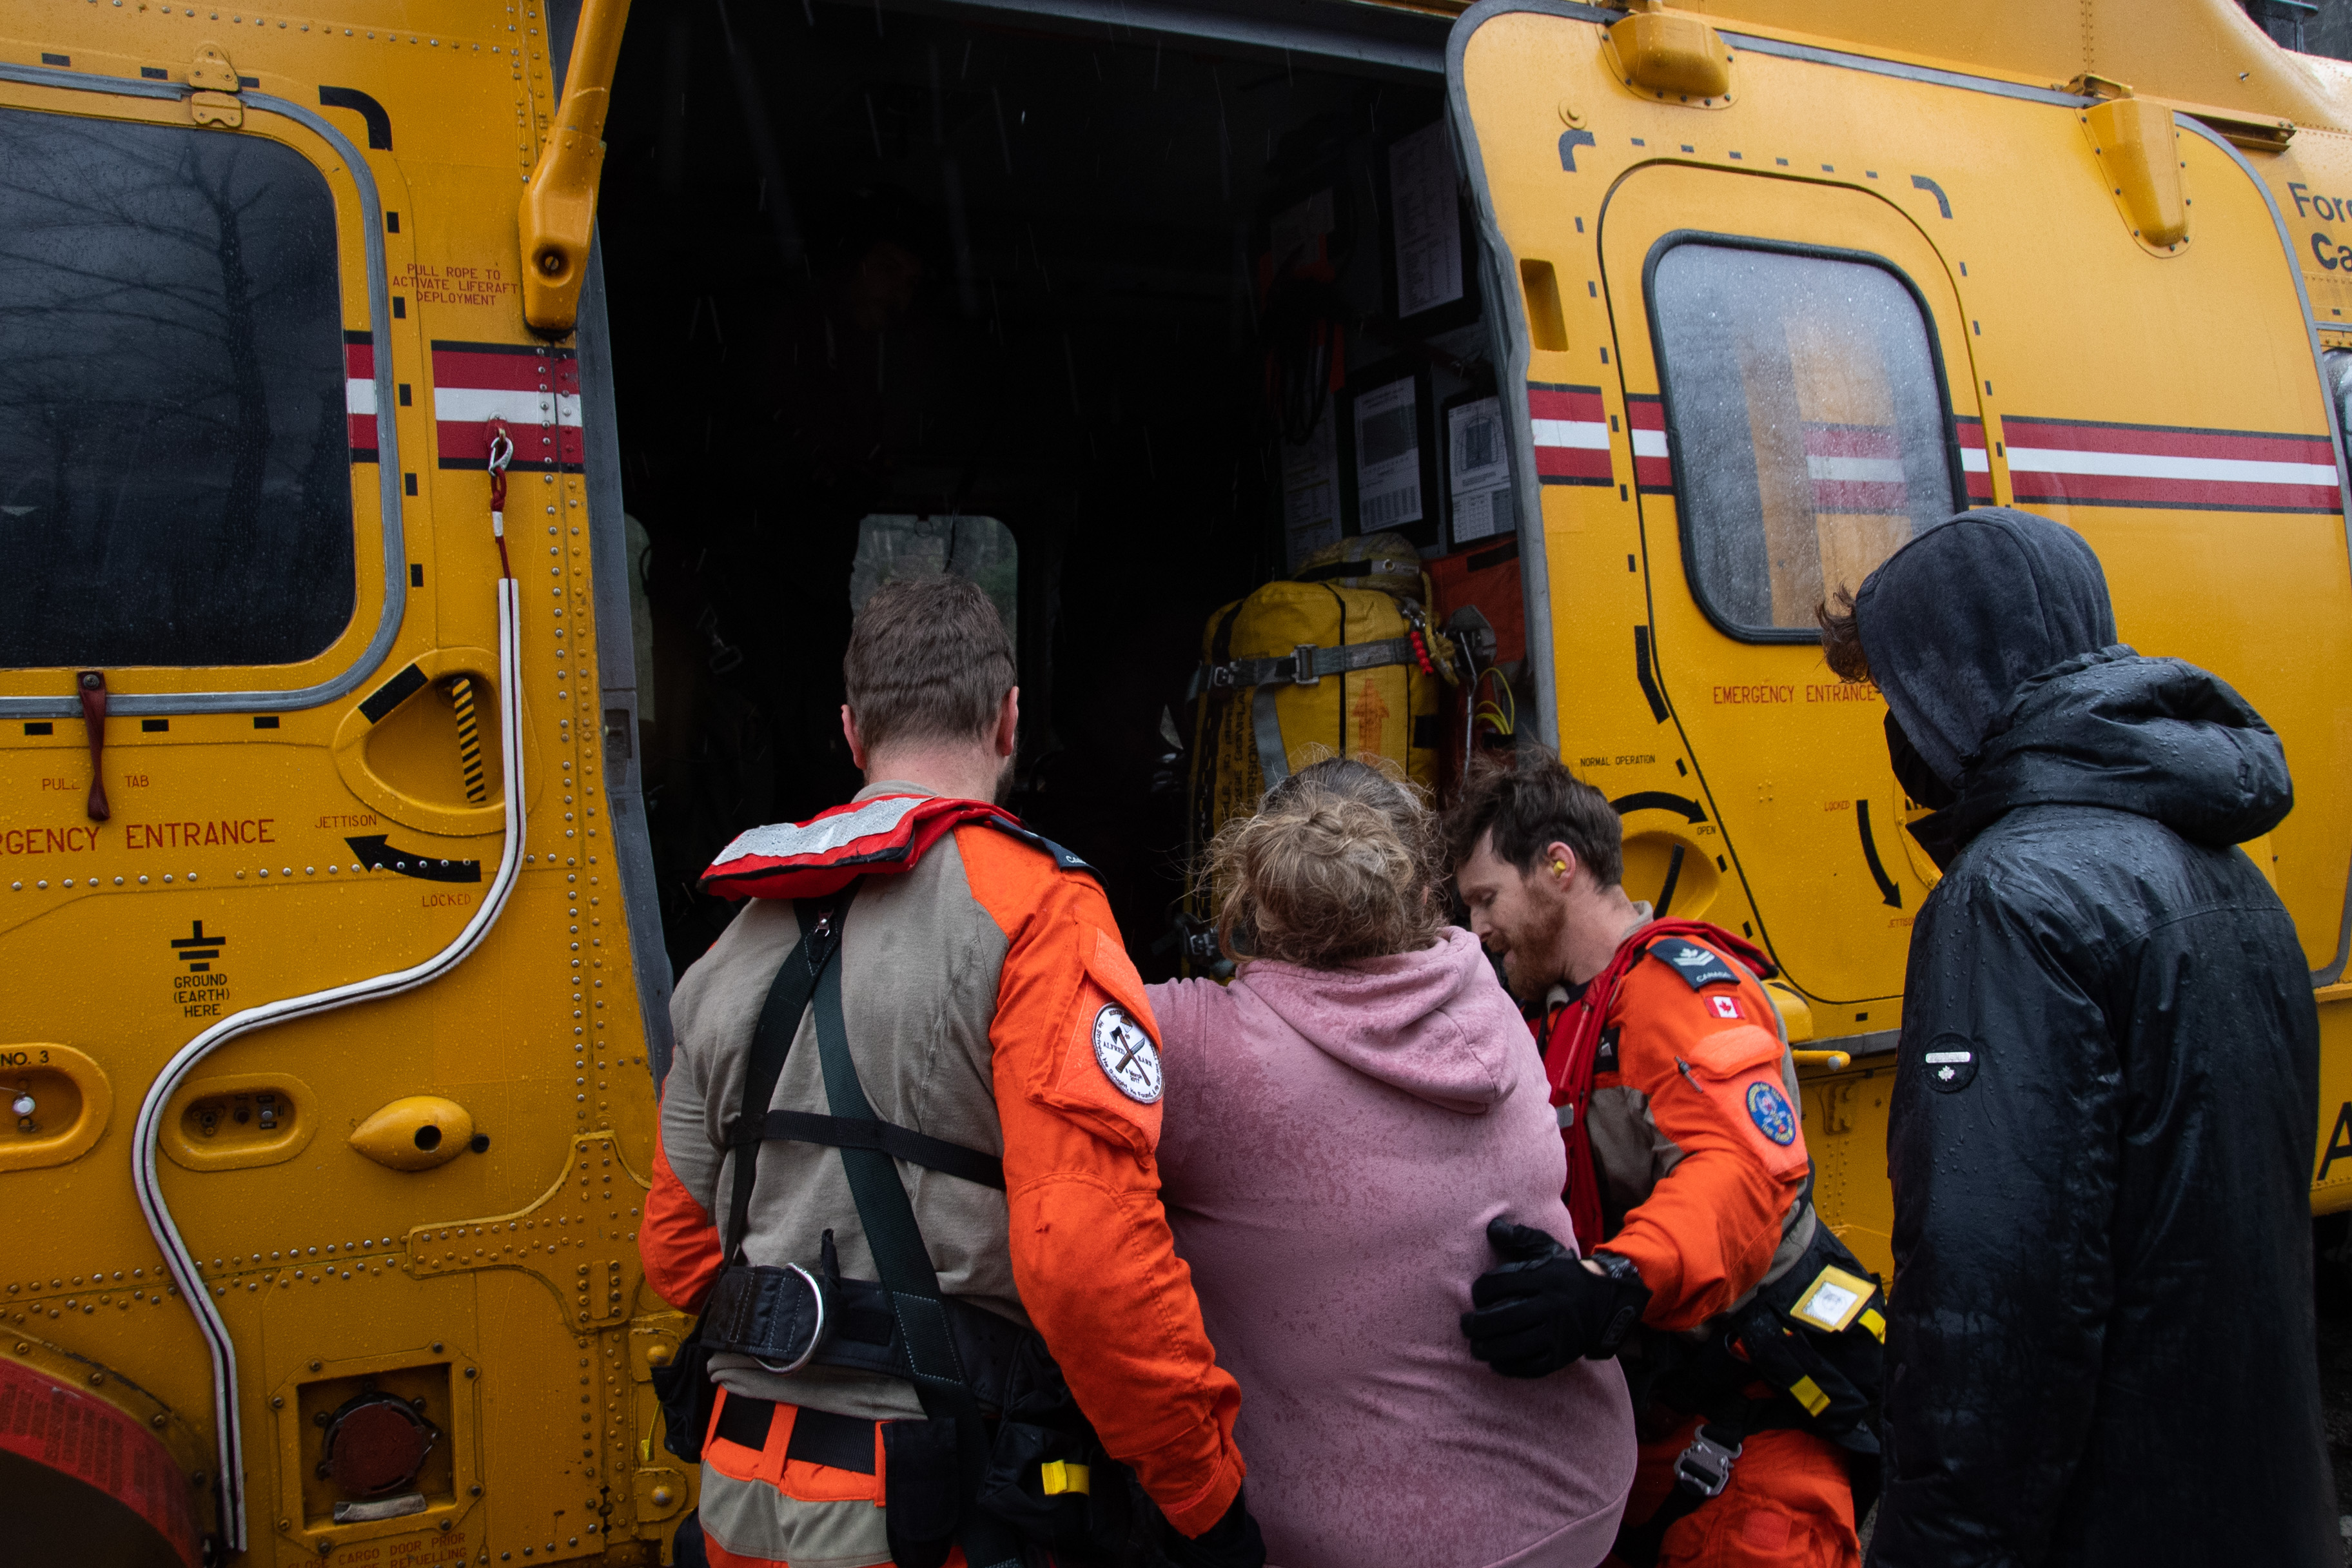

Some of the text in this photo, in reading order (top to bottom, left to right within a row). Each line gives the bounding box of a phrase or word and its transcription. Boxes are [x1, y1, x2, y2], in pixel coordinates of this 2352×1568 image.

[407, 263, 500, 280] PULL ROPE TO
[393, 276, 518, 295] ACTIVATE LIFERAFT
[416, 291, 496, 306] DEPLOYMENT
[1713, 683, 1876, 705] EMERGENCY ENTRANCE
[1580, 754, 1656, 767] NORMAL OPERATION
[124, 775, 150, 788] TAB
[1824, 799, 1851, 812] LOCKED
[315, 814, 377, 829] JETTISON
[0, 818, 276, 855] GENCY ENTRANCE
[1697, 825, 1716, 836] OPEN
[422, 893, 471, 908] LOCKED
[174, 974, 228, 989] GROUND
[173, 988, 230, 1004] (EARTH)
[184, 1004, 221, 1017] HERE
[0, 1050, 49, 1066] NO. 3
[2316, 1101, 2352, 1181] A
[338, 1548, 380, 1566] CARGO
[389, 1540, 422, 1556] DOOR
[431, 1533, 466, 1548] PRIOR
